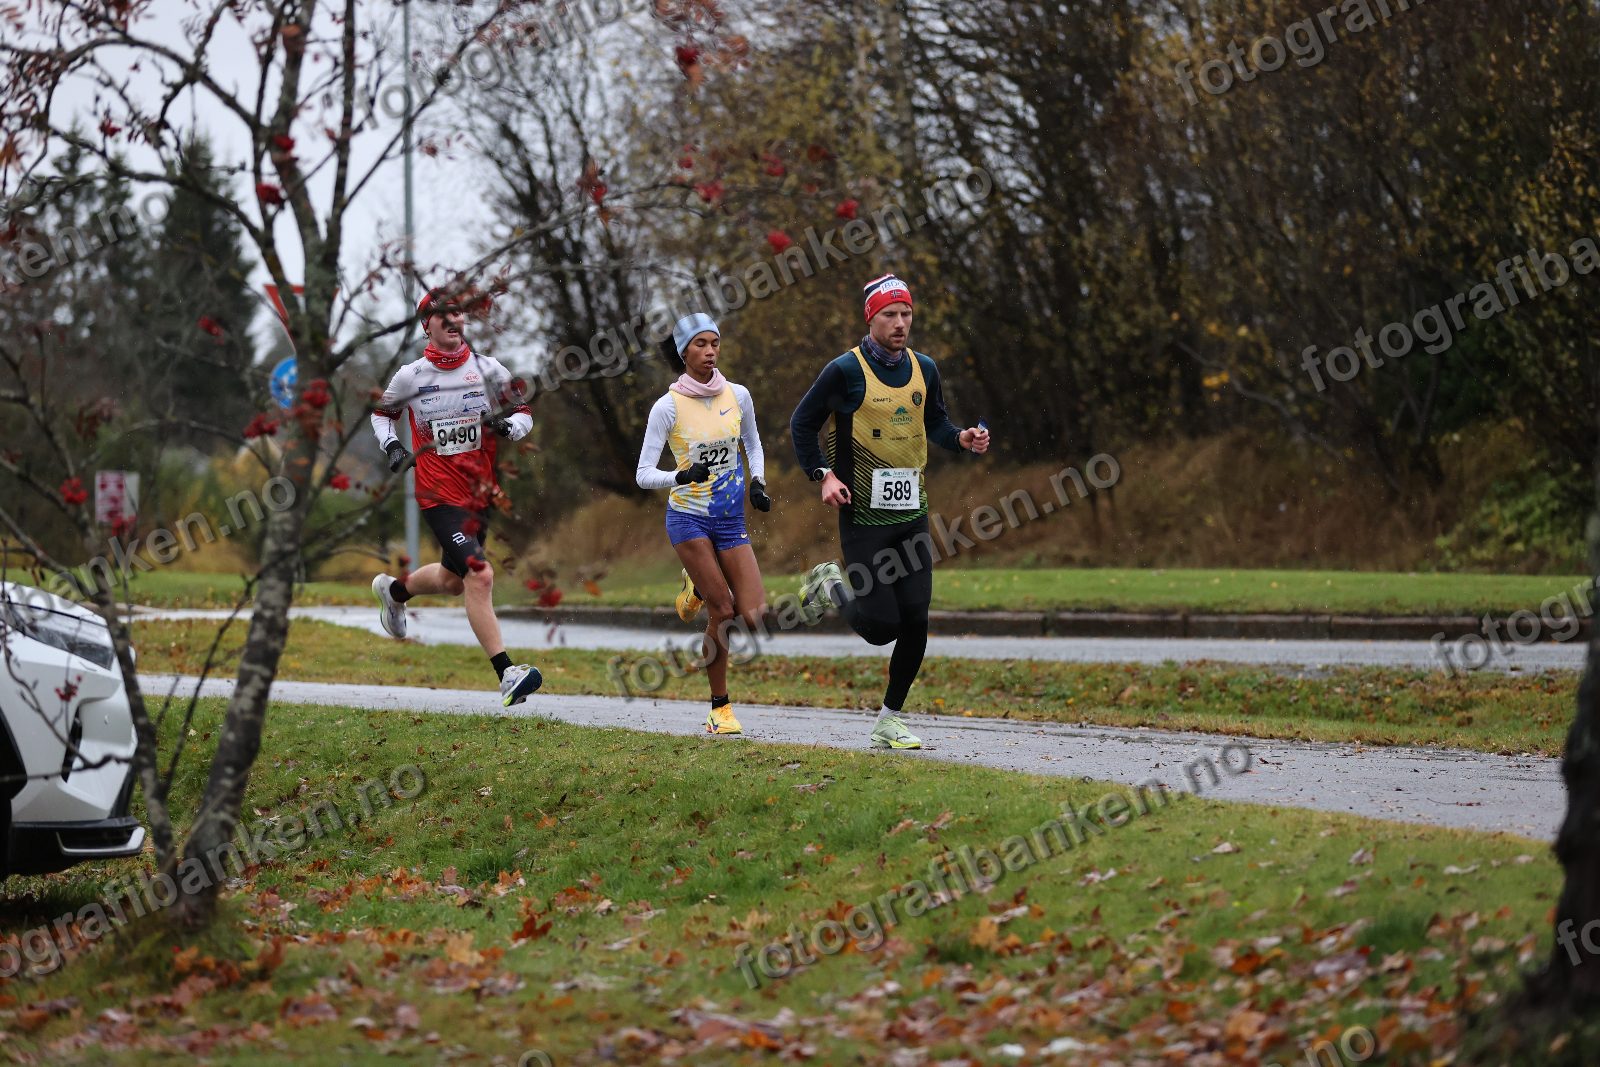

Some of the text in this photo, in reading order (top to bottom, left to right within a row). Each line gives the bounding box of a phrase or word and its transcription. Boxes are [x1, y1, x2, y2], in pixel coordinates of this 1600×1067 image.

[437, 425, 477, 447] 9490
[699, 447, 729, 467] 522
[882, 480, 912, 501] 589
